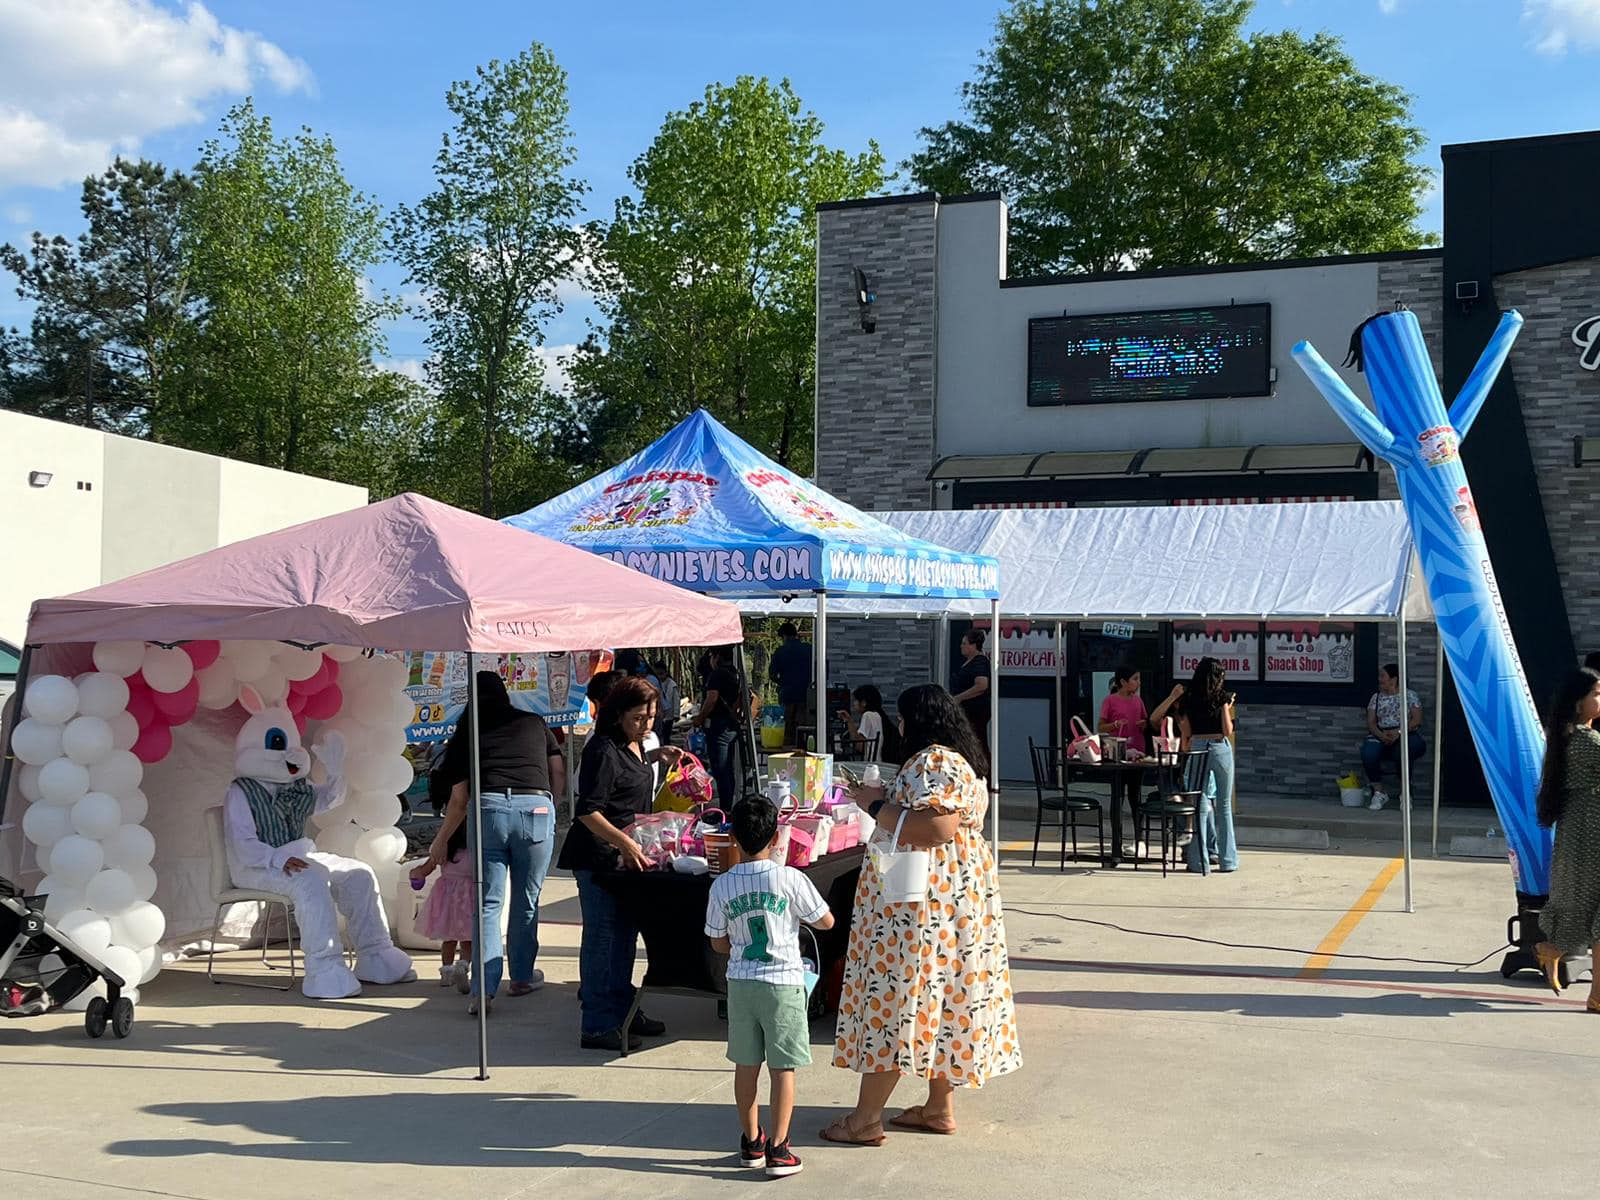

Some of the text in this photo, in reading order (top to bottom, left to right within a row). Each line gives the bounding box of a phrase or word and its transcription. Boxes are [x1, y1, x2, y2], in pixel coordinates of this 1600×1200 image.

[1104, 624, 1132, 637] OPEN
[1267, 655, 1324, 673] Snack Shop
